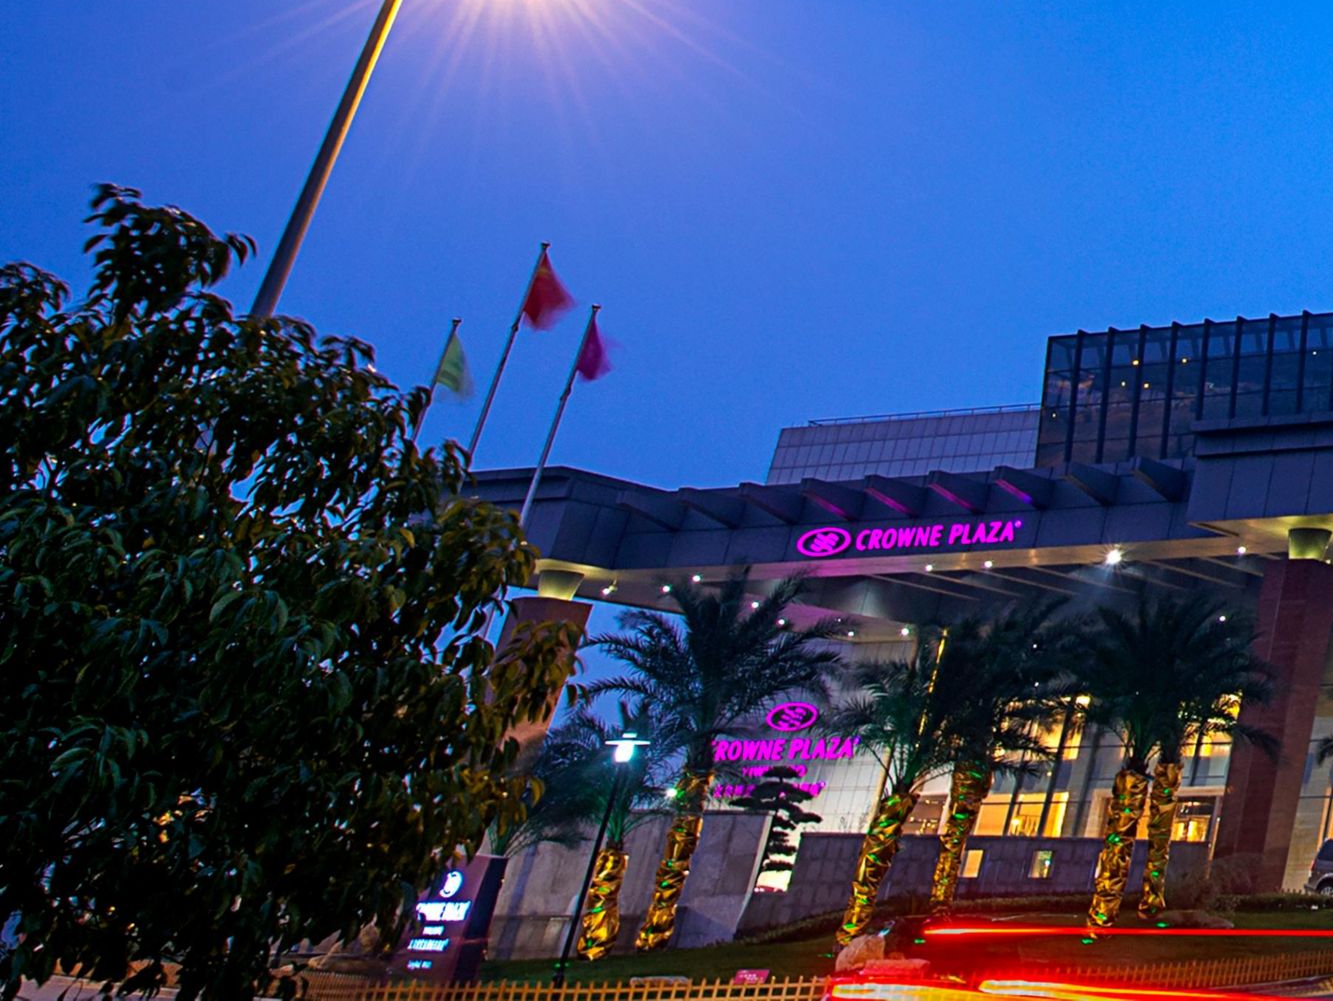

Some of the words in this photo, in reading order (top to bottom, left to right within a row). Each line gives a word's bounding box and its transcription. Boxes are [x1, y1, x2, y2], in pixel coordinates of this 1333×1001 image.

[855, 524, 943, 551] CROWNE
[949, 521, 1014, 545] PLAZA
[712, 739, 786, 762] ROWNE
[787, 736, 857, 760] PLAZA
